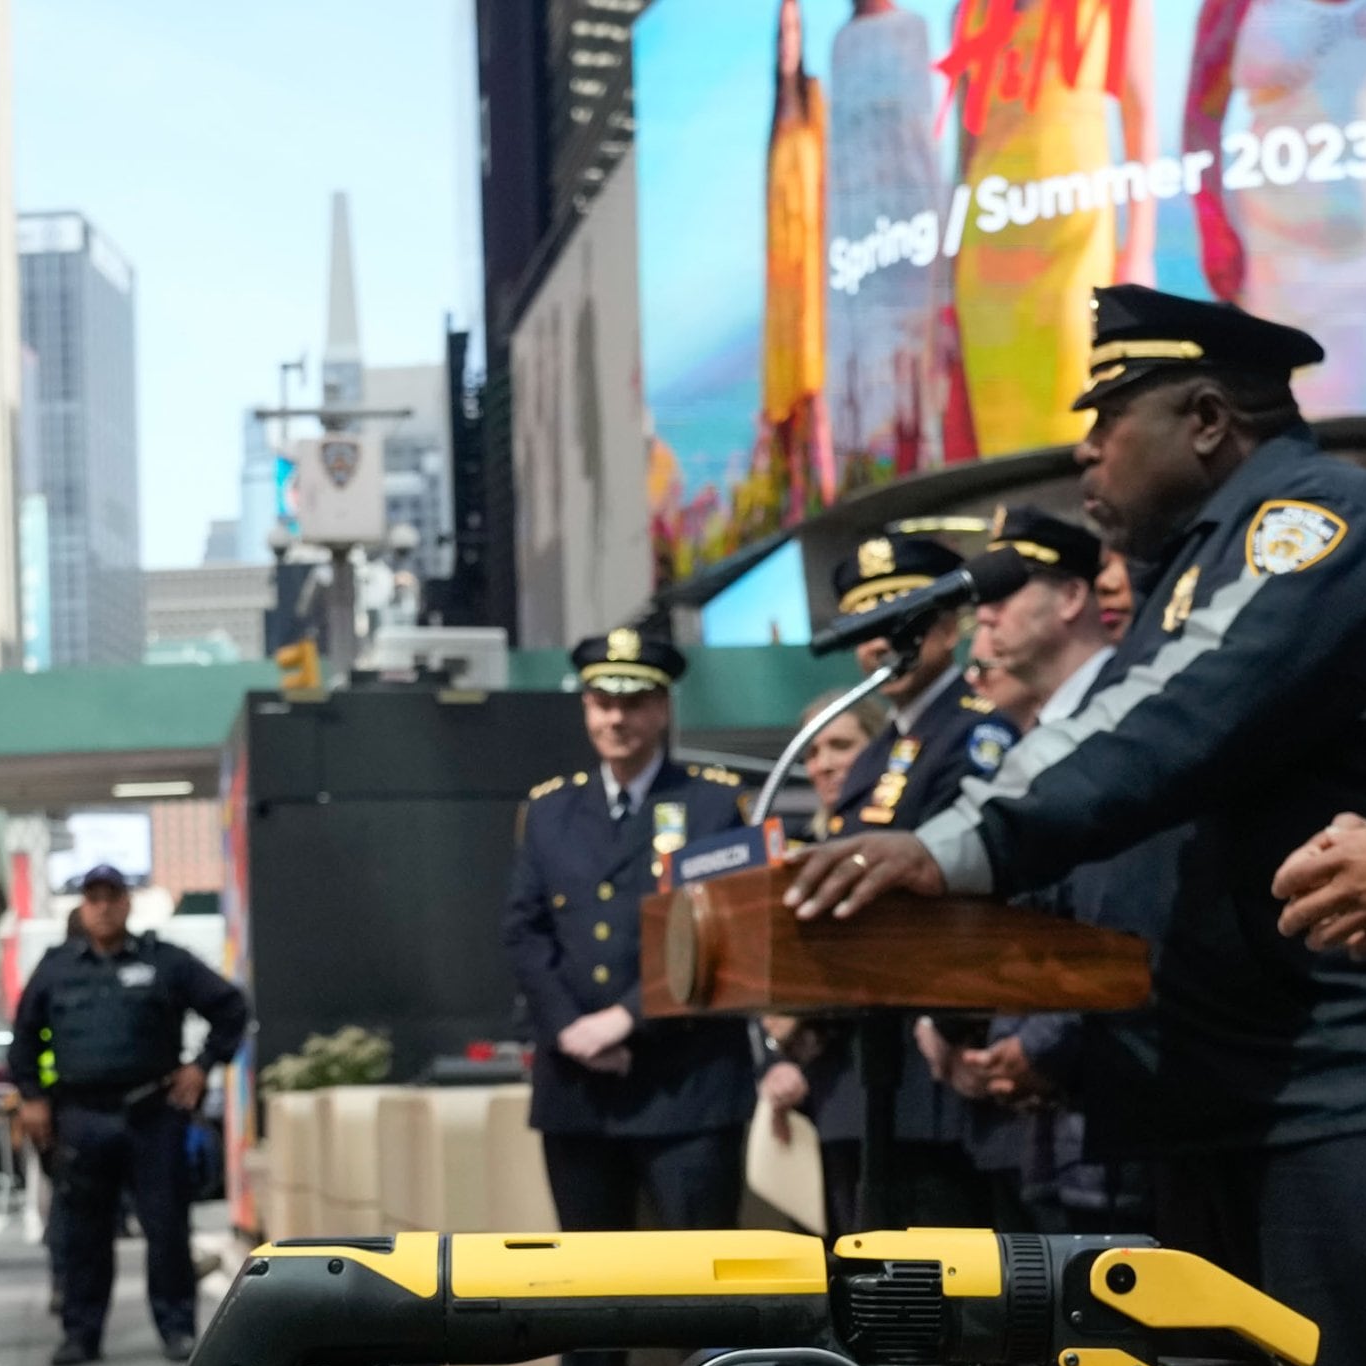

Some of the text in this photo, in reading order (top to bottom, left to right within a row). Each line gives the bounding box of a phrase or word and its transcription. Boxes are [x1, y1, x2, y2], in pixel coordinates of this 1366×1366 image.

[933, 0, 1132, 138] H&M
[829, 210, 937, 294] Spring
[975, 150, 1213, 233] Summer
